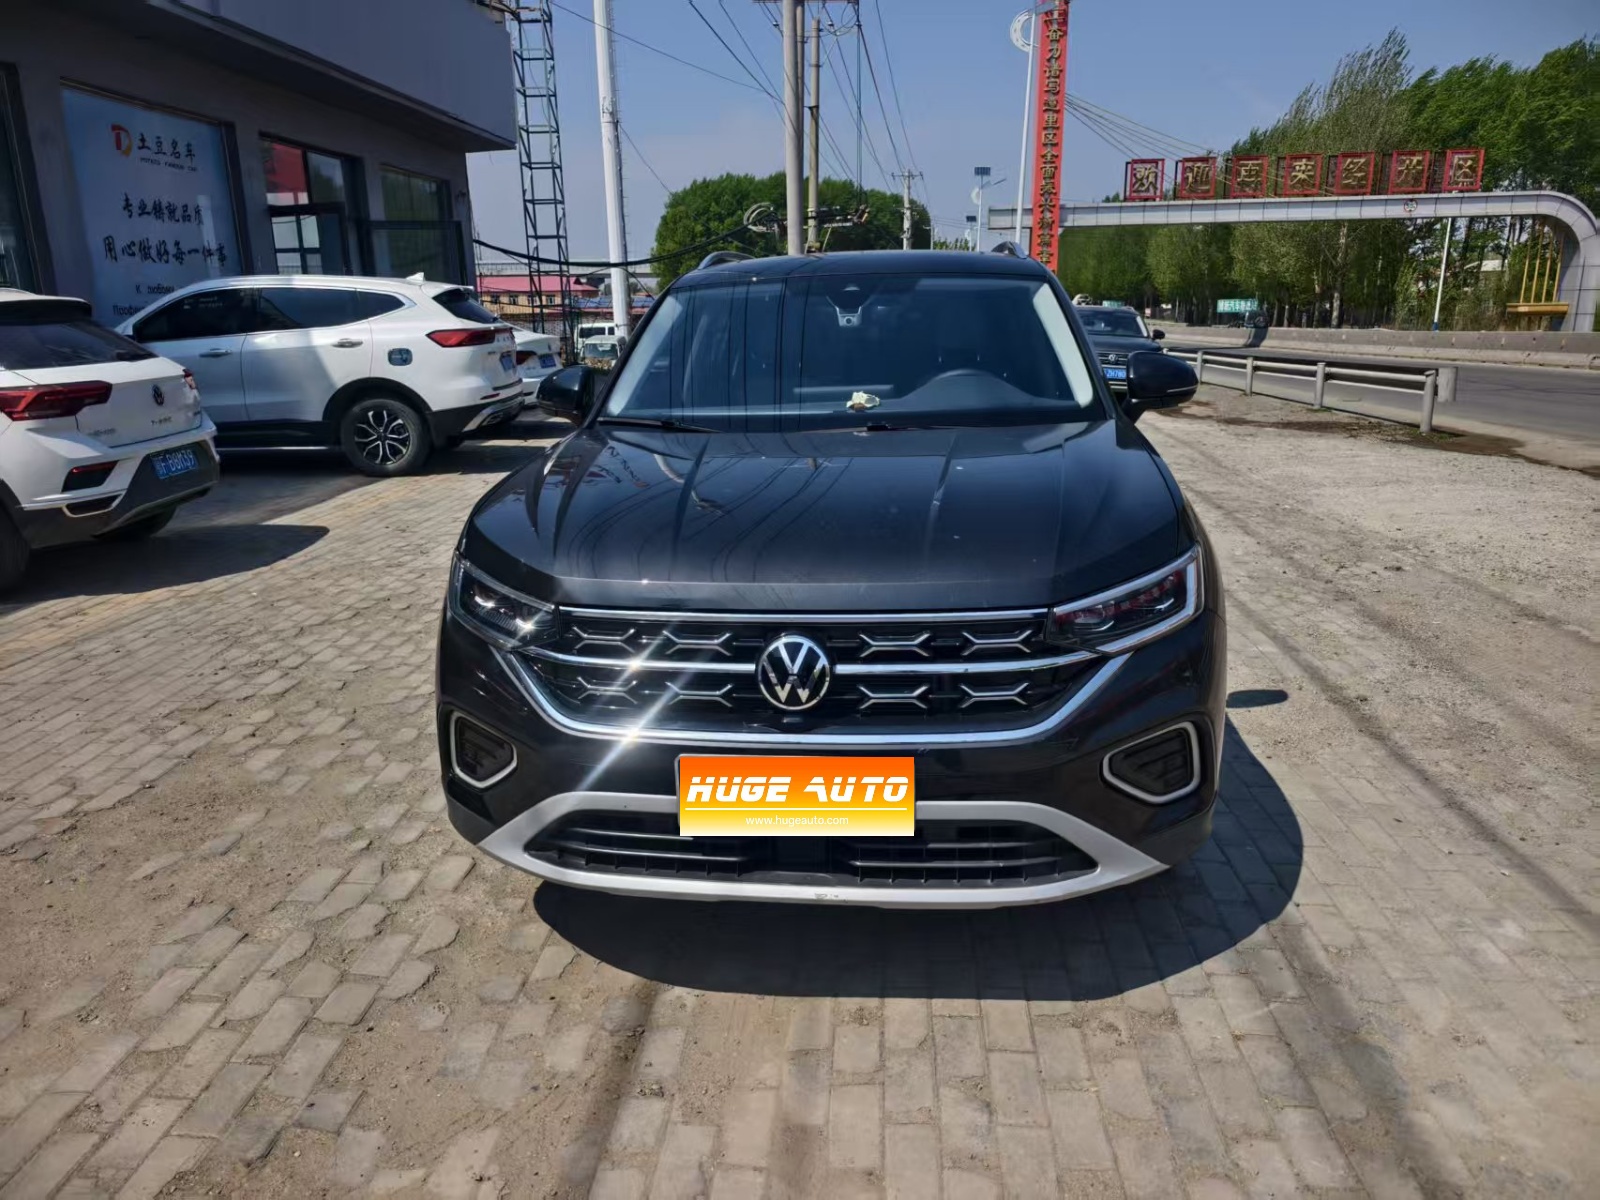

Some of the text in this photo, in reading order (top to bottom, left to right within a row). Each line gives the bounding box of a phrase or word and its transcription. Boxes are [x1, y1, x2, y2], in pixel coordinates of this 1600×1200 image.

[138, 132, 196, 164] 土豆名车
[103, 235, 227, 267] 用心做好每一件事
